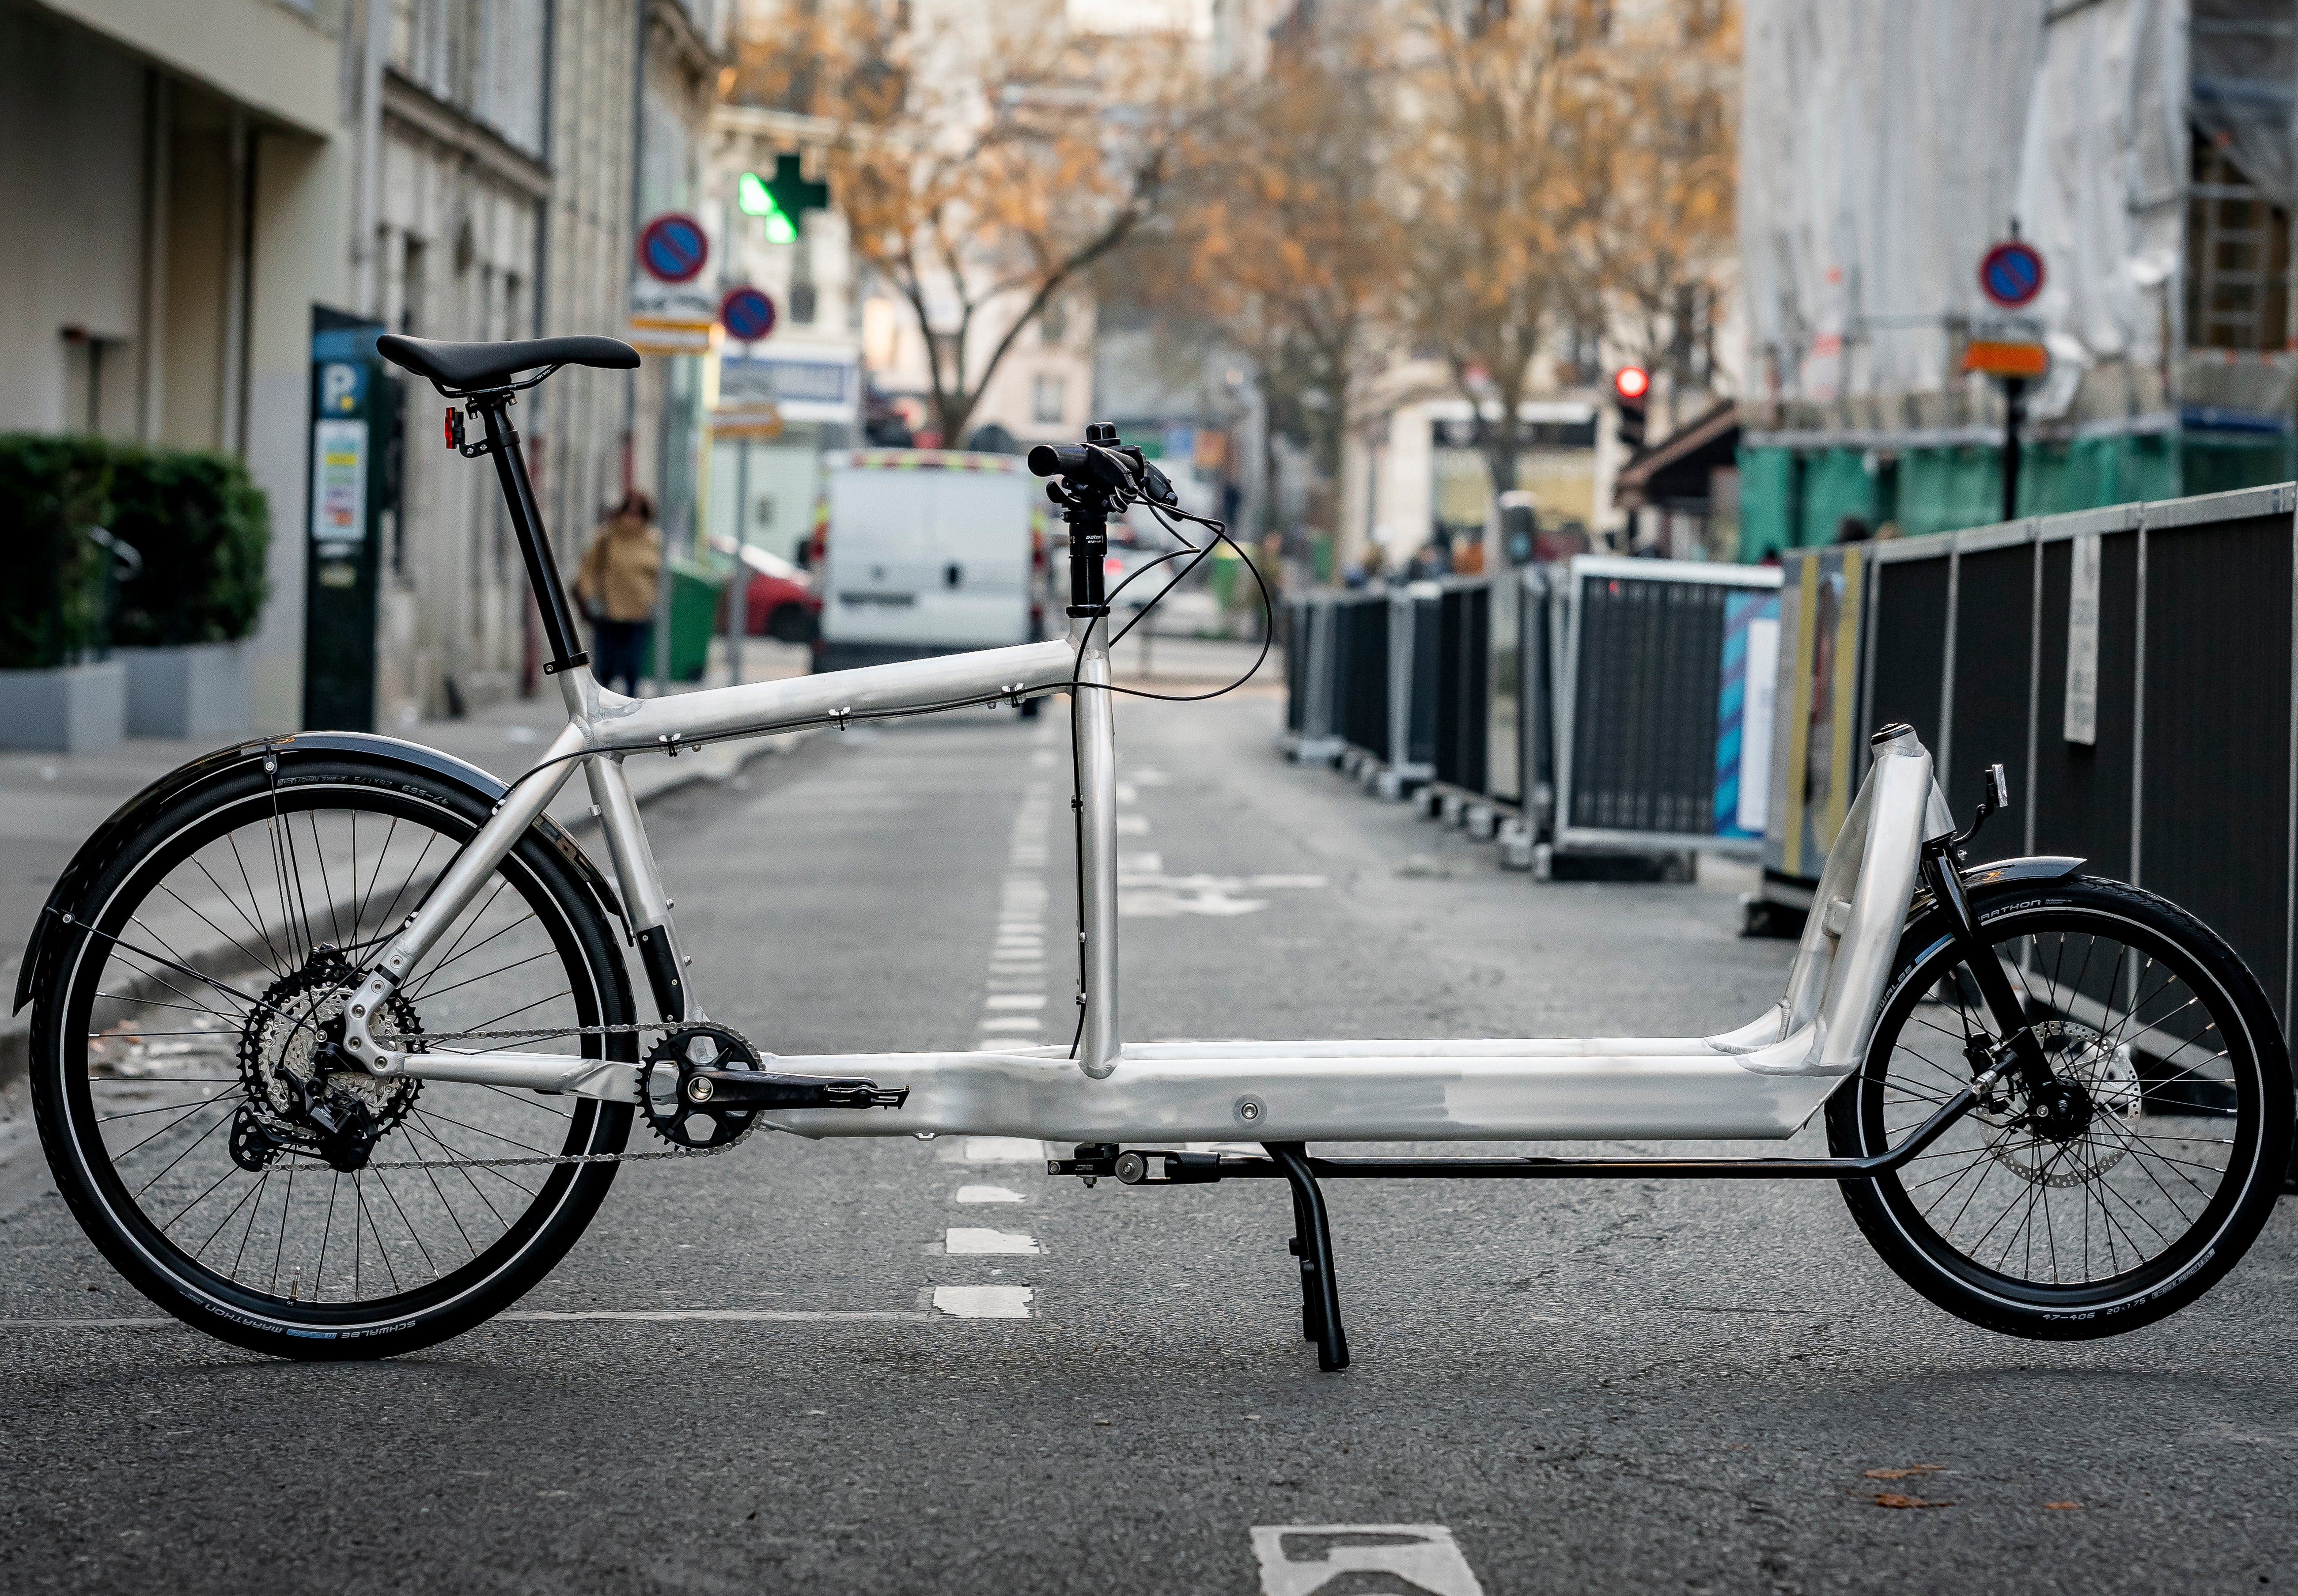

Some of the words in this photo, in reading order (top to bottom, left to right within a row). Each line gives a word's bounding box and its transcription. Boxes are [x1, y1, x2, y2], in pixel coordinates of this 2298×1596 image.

[402, 784, 449, 805] 47-559
[1978, 900, 2041, 921] RATHON
[204, 1304, 283, 1333] MARATHON
[341, 1320, 416, 1338] SCHWALBE
